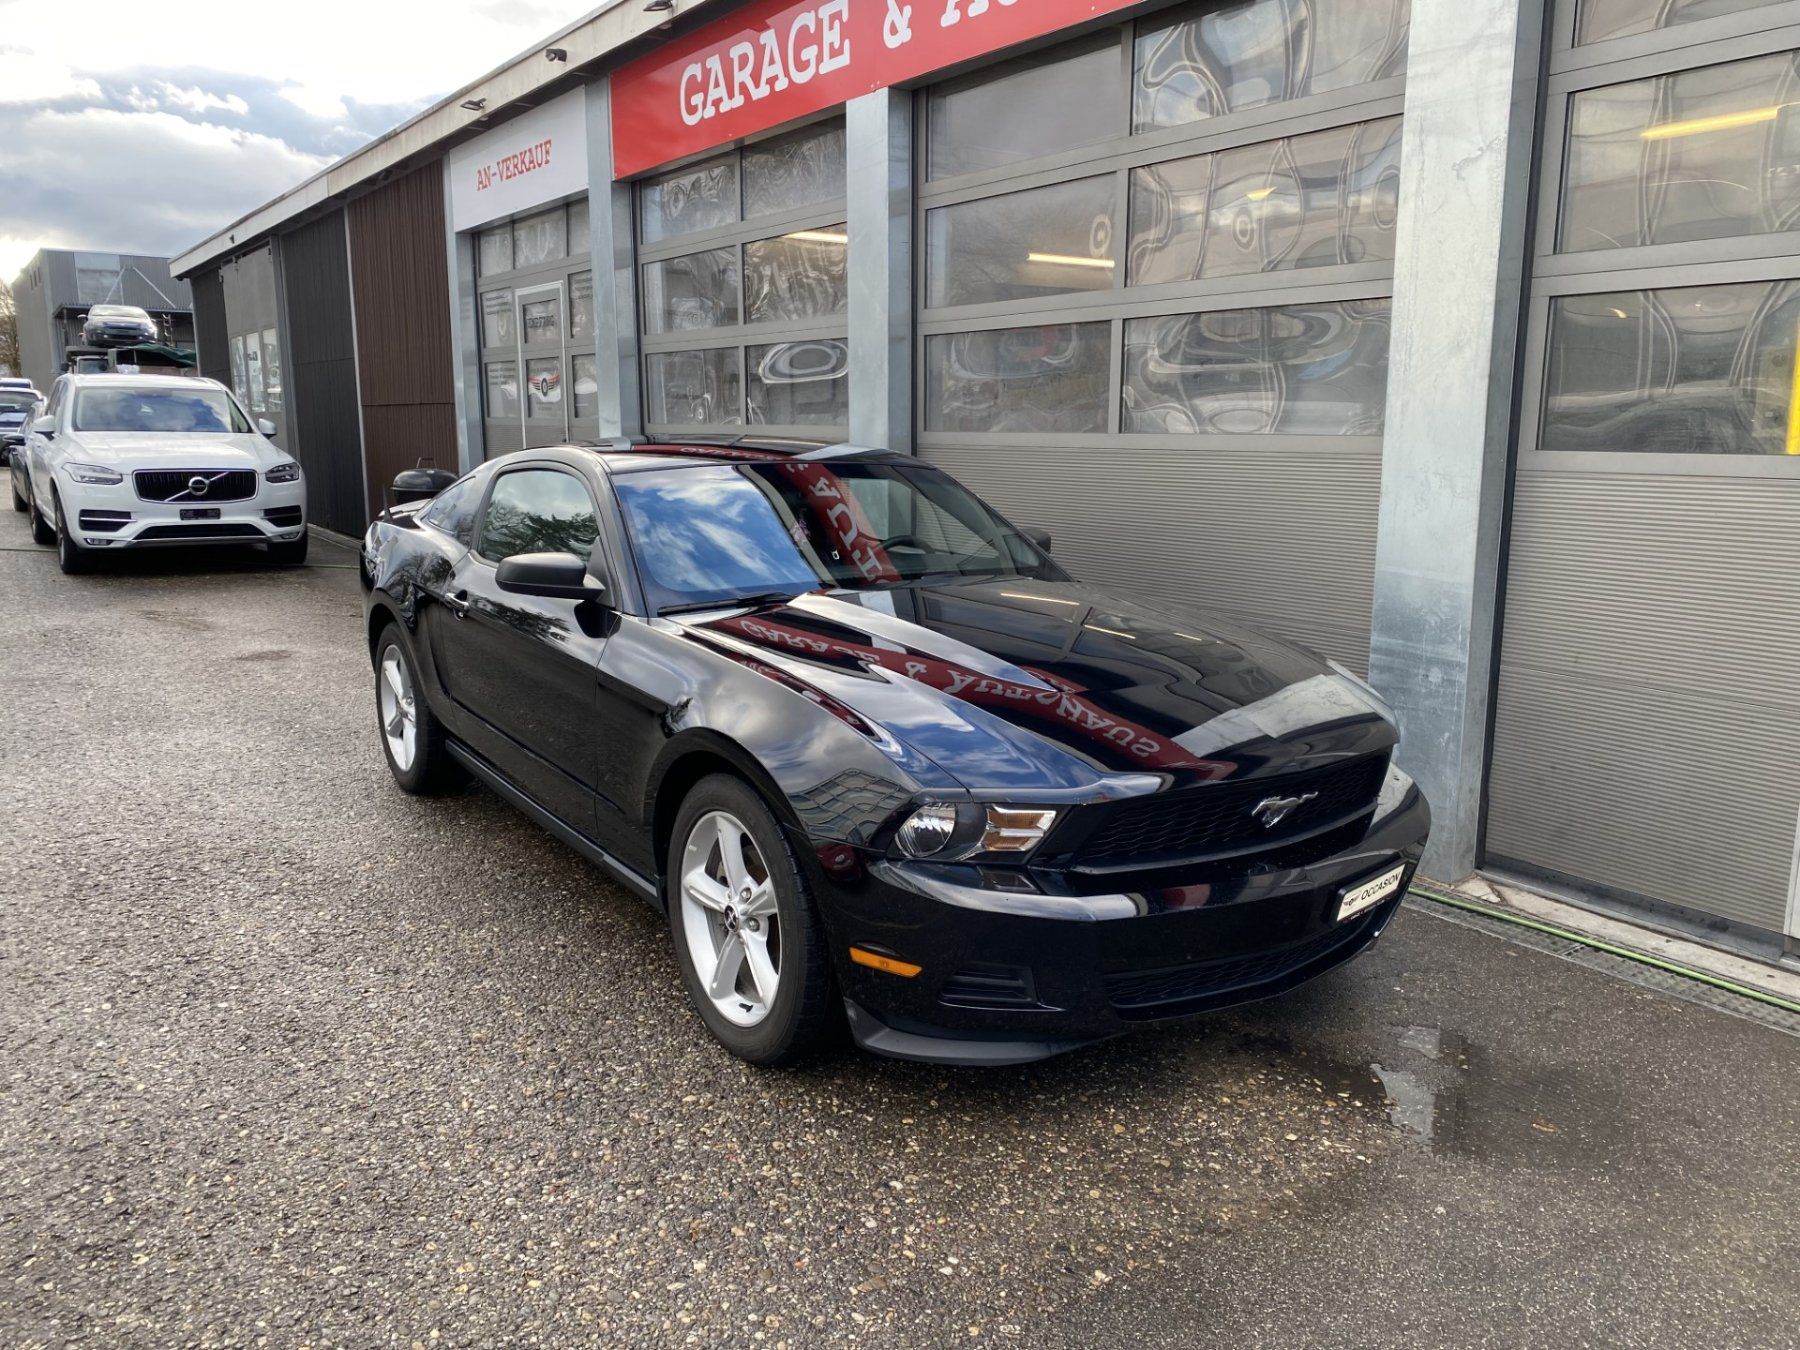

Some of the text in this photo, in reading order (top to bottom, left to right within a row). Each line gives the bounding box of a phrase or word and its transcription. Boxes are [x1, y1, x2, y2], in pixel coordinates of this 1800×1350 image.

[680, 0, 912, 126] GARAGE &
[477, 139, 552, 191] AN-VERKAUF
[1361, 871, 1401, 900] OCCASION
